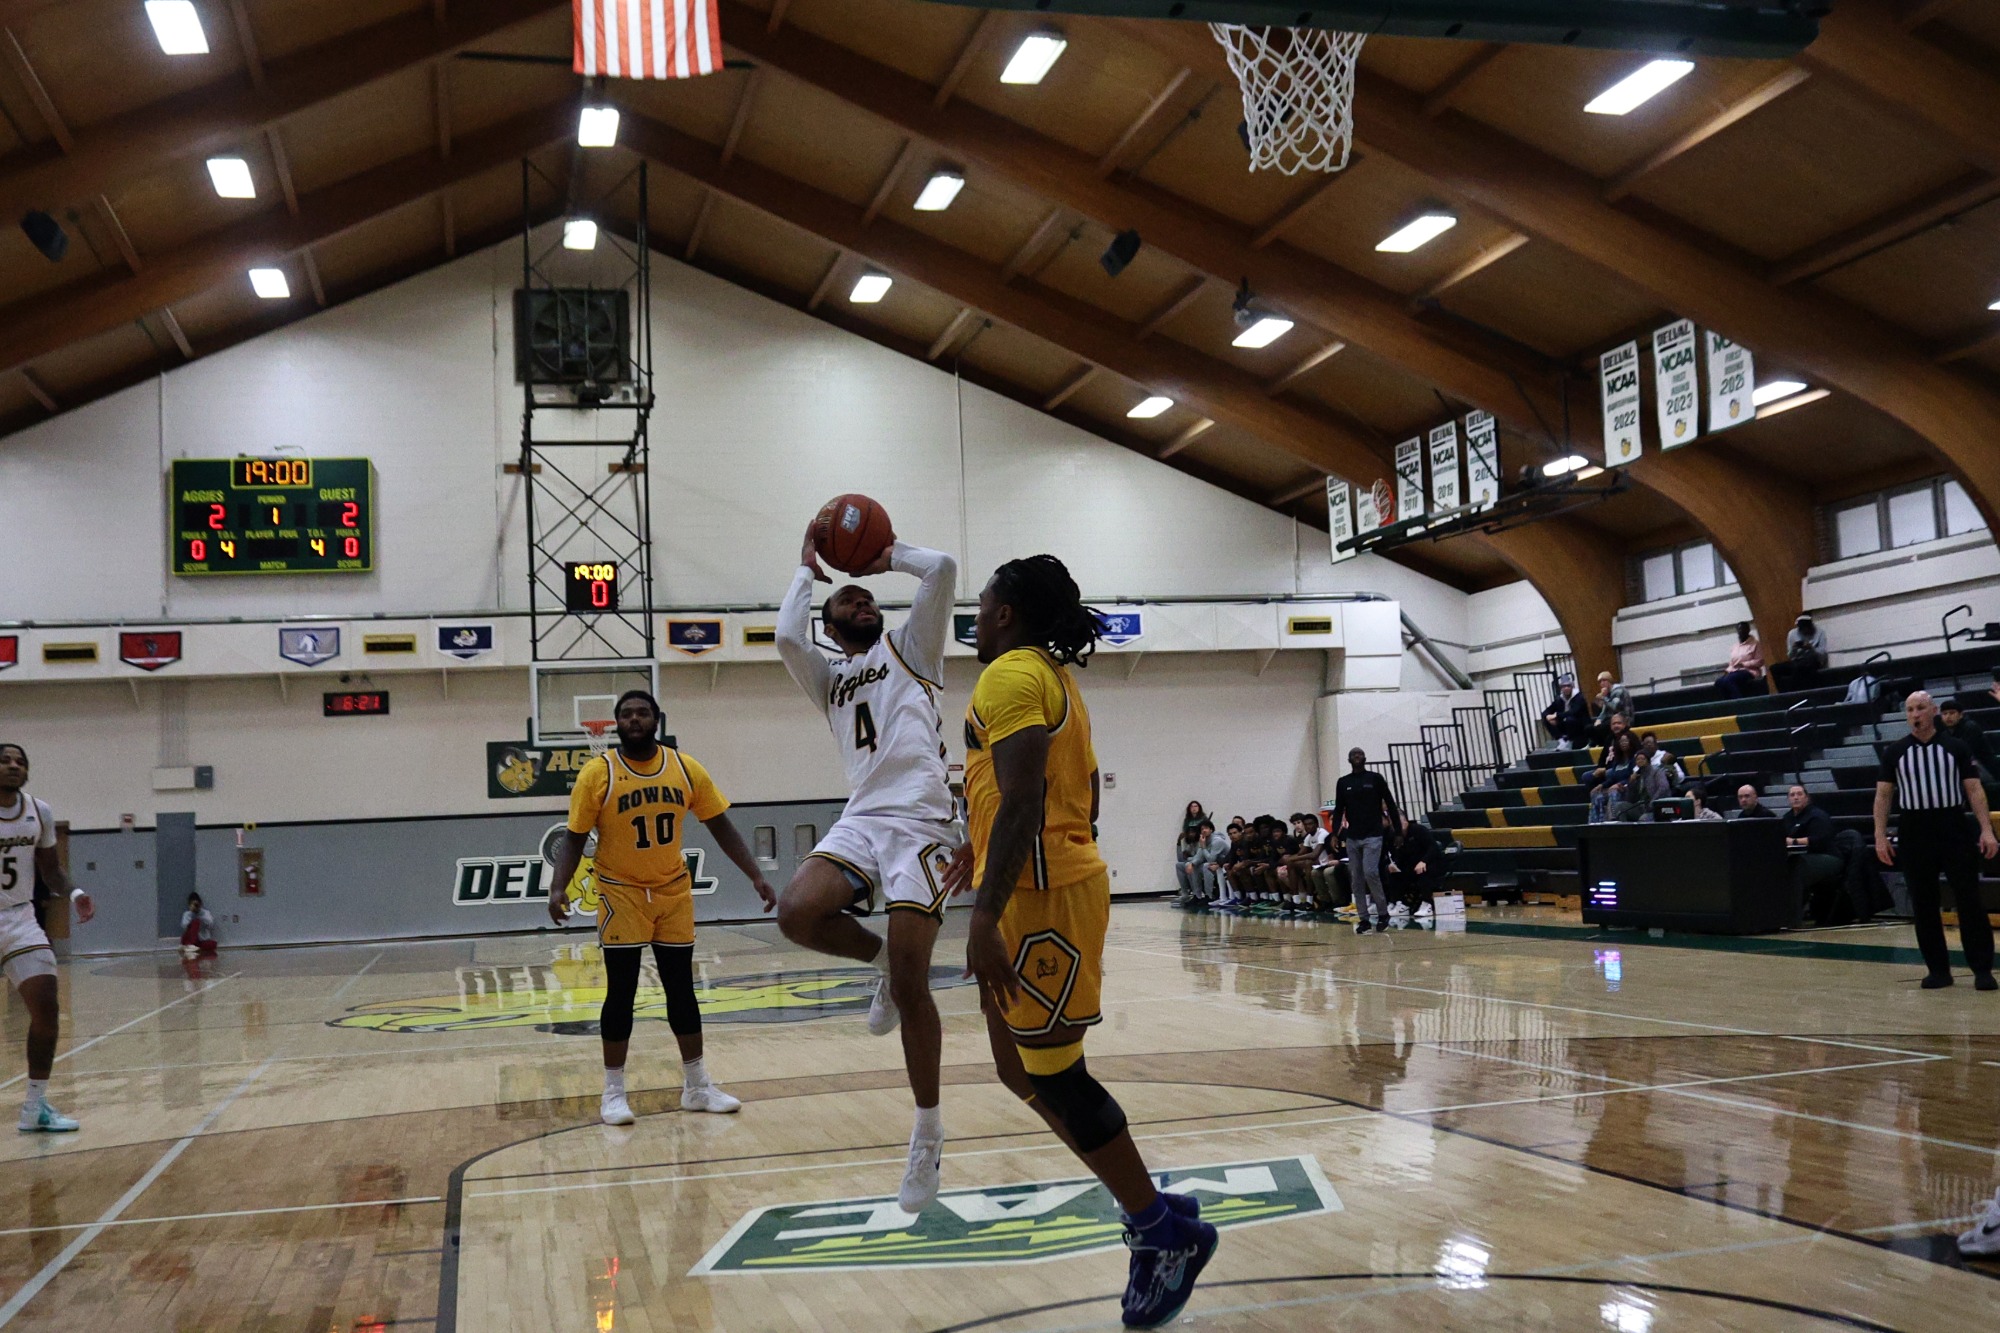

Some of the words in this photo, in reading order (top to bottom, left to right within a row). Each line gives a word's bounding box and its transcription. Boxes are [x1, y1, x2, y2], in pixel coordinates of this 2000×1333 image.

[1659, 347, 1693, 375] NCAA
[1607, 371, 1637, 397] NCAA
[1667, 392, 1693, 416] 2023
[1614, 409, 1636, 431] 2022
[1433, 446, 1455, 465] NCAA
[246, 460, 307, 485] 19:00
[183, 490, 225, 503] AGGIES
[320, 488, 356, 501] GUEST
[209, 504, 226, 530] 2
[272, 507, 280, 525] 1
[342, 502, 359, 527] 2
[191, 540, 206, 560] 0
[220, 540, 235, 558] 4
[311, 539, 325, 556] 4
[345, 537, 359, 557] 0
[574, 564, 614, 581] 19:00
[592, 581, 608, 607] 0
[830, 662, 890, 708] Aggies
[855, 701, 878, 754] 4
[546, 750, 592, 771] AG
[618, 786, 685, 815] ROWAN
[631, 812, 675, 849] 10
[1, 856, 18, 891] 5
